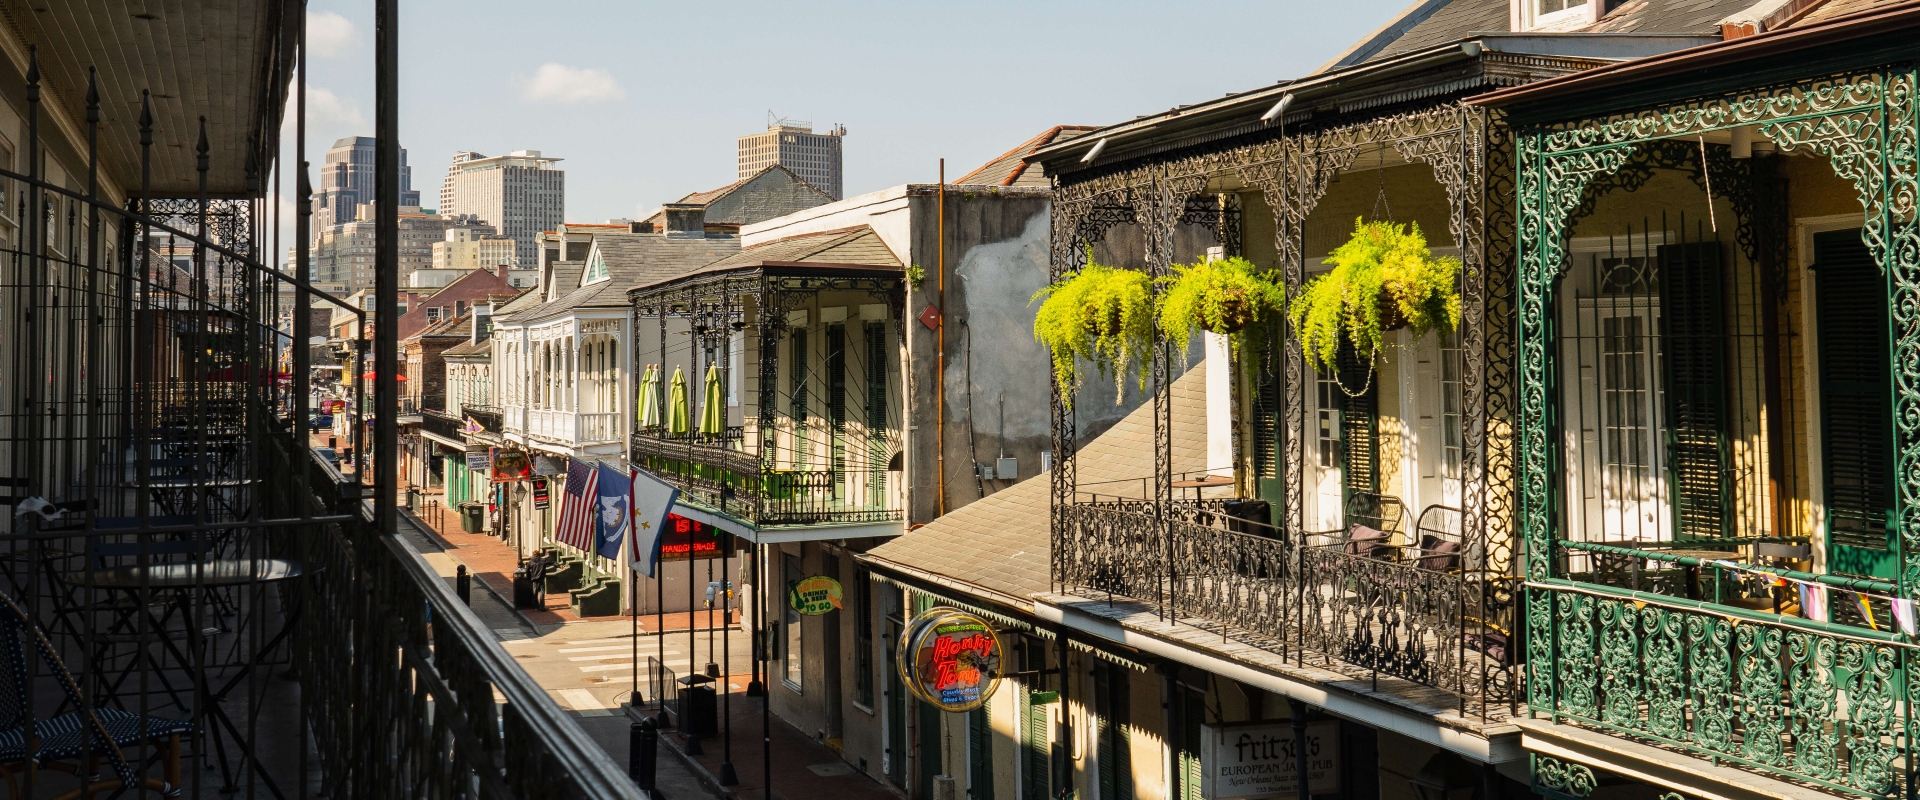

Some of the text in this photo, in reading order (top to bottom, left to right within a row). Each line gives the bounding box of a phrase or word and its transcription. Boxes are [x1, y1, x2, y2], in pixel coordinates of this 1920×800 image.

[803, 589, 829, 598] DRINKS
[805, 601, 831, 613] TO GO
[934, 633, 994, 663] Honky
[936, 660, 981, 690] Tonk
[1235, 733, 1320, 764] fritze's
[1221, 760, 1333, 776] EUROPEAN JA PUB
[1228, 777, 1246, 788] New
[1247, 776, 1272, 785] Orleans
[1272, 775, 1289, 784] Jazz
[1308, 771, 1325, 780] 1969
